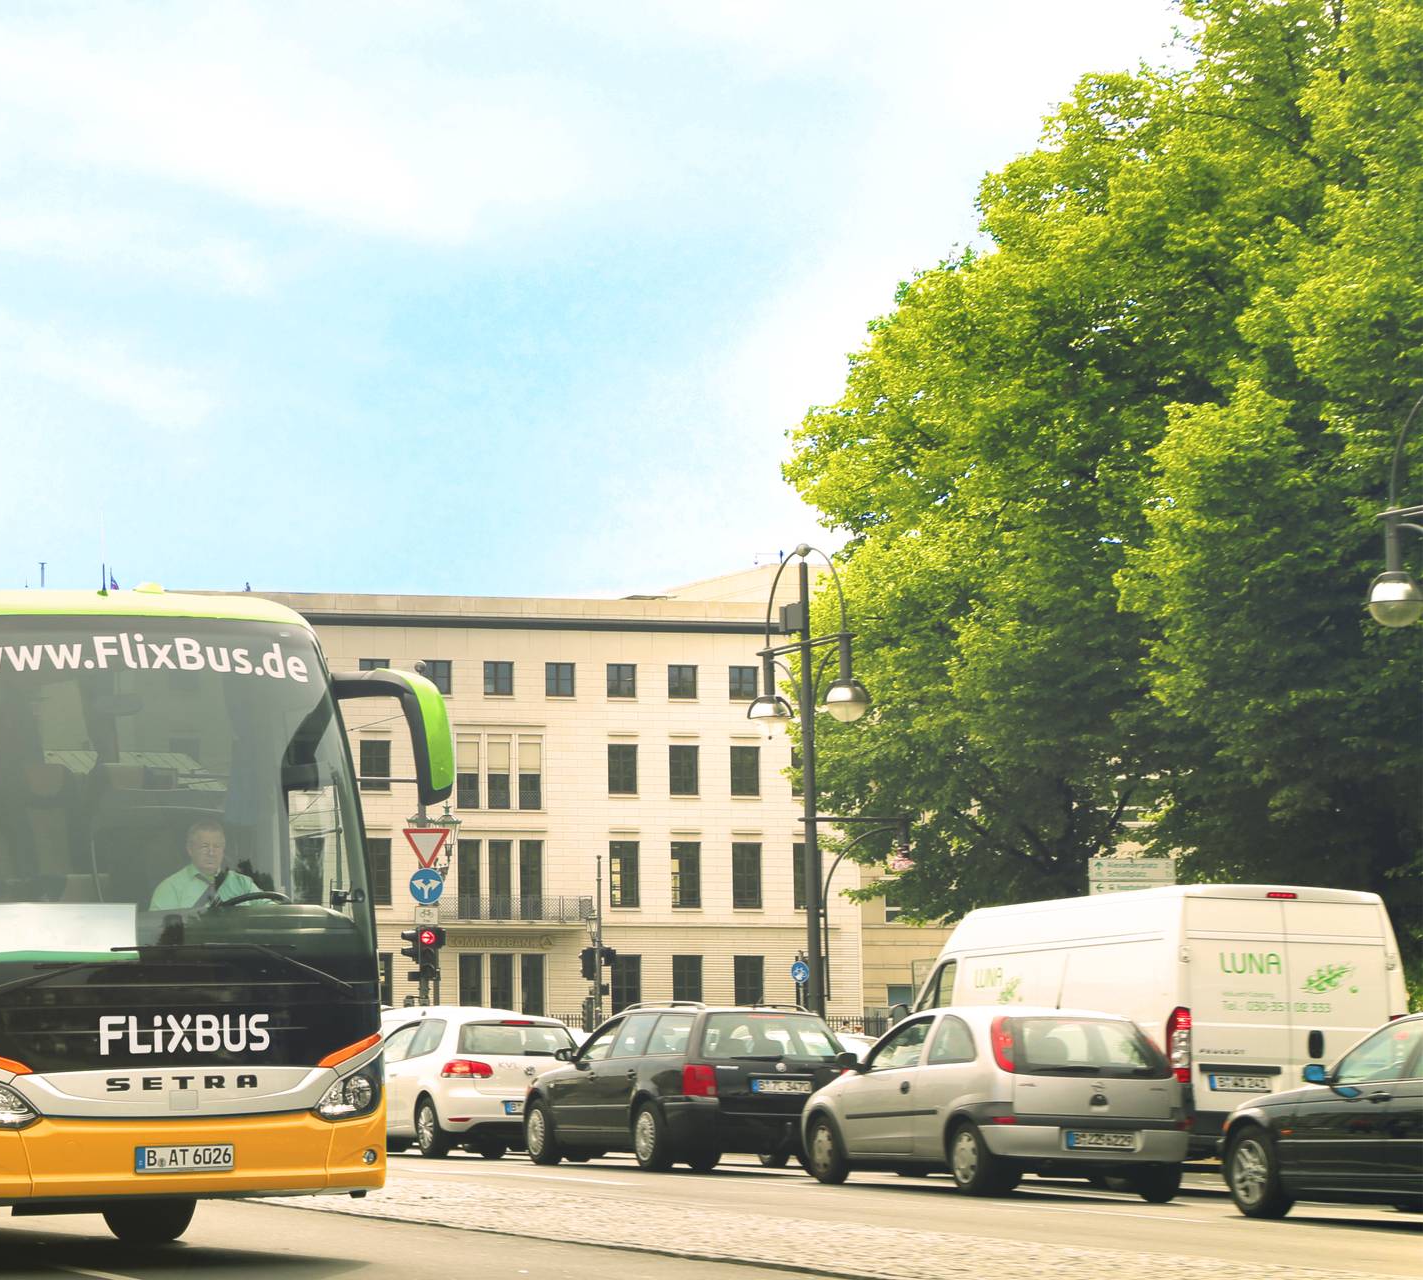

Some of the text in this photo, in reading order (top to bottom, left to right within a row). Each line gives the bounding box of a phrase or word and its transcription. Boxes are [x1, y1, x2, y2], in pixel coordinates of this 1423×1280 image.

[1219, 952, 1282, 974] LUNA
[975, 967, 1003, 988] LUNA
[106, 1075, 258, 1092] SETRA
[168, 1149, 189, 1165] AT
[192, 1148, 232, 1164] 6026
